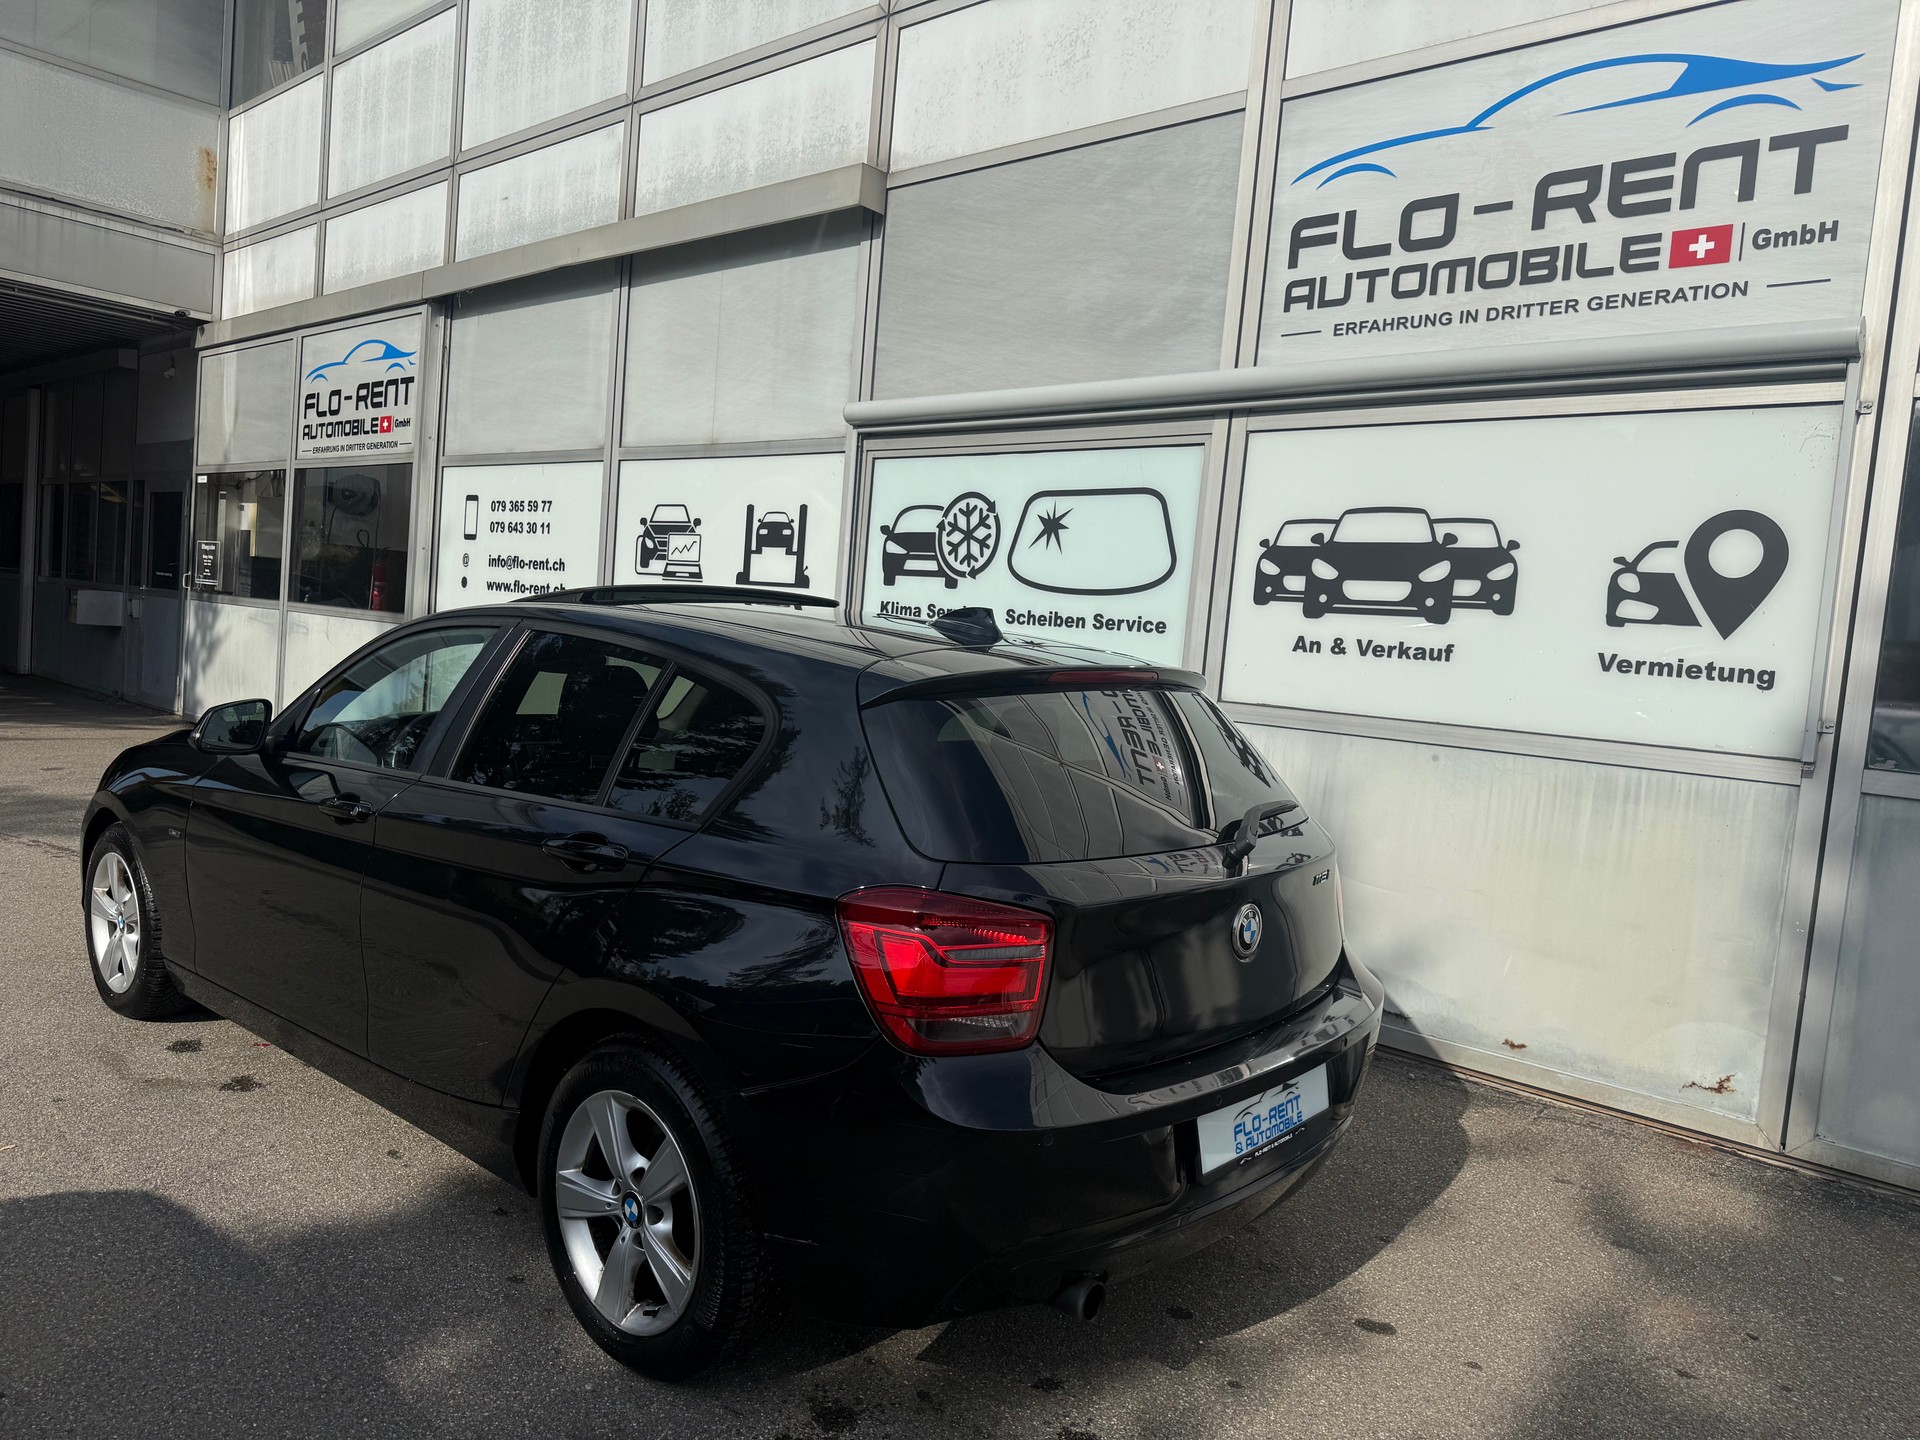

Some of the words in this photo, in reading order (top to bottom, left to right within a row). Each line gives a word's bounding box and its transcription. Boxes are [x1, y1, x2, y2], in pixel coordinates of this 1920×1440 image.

[1283, 233, 1662, 312] AUTOMOBILE
[1752, 220, 1839, 250] GmbH
[1333, 312, 1452, 336] ERFAHRUNG
[1459, 309, 1479, 324] IN
[1486, 299, 1579, 321] DRITTER
[1587, 281, 1749, 311] GENERATION
[303, 417, 379, 440] AUTOMOBILE
[395, 418, 411, 429] GmbH
[312, 445, 340, 454] ERFAHRUNG
[340, 444, 346, 452] IN
[346, 443, 366, 451] DRITTER
[366, 441, 398, 450] GENERATION
[491, 500, 506, 512] 079
[509, 500, 525, 512] 365
[527, 500, 538, 512] 59
[541, 500, 552, 512] 77
[489, 521, 505, 533] 079
[508, 522, 524, 534] 643
[526, 522, 537, 534] 30
[540, 522, 550, 534] 11
[488, 554, 565, 571] info@flo-rent.ch
[486, 580, 566, 595] www.flo-rentch
[880, 601, 921, 618] Klima
[1005, 608, 1086, 629] Scheiben
[1092, 613, 1167, 634] Service
[1292, 635, 1322, 653] An
[1330, 637, 1347, 655] &
[1356, 639, 1455, 662] Verkauf
[1598, 652, 1776, 691] Vermietung
[1233, 1094, 1300, 1141] FLO-RENT
[1236, 1142, 1243, 1154] &
[1246, 1111, 1302, 1150] AUTOMOBILE
